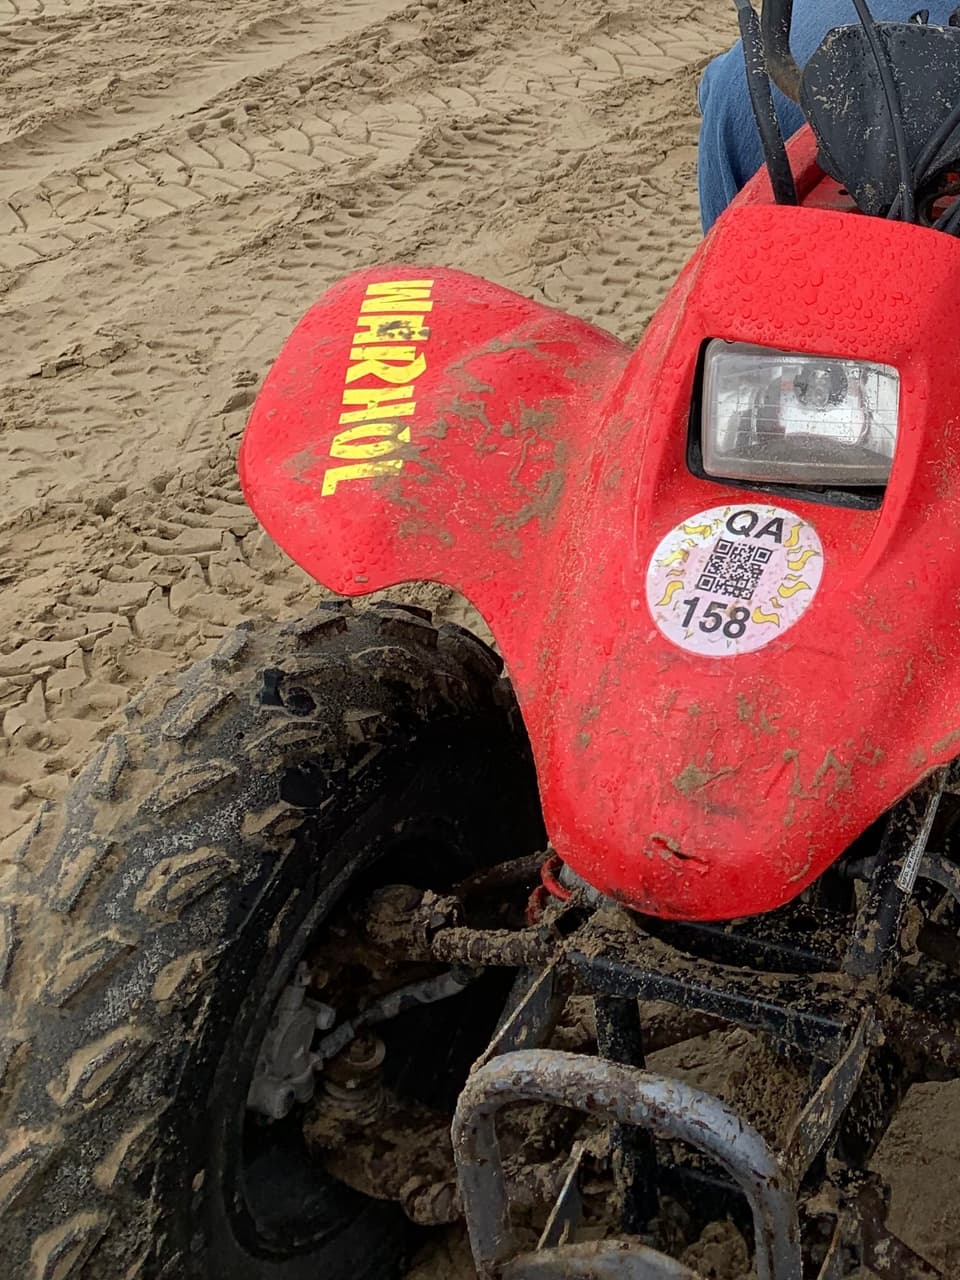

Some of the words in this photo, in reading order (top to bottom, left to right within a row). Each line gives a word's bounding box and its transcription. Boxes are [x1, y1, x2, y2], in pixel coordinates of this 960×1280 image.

[321, 280, 434, 497] WARHOL
[725, 509, 785, 544] QA
[681, 596, 751, 639] 158
